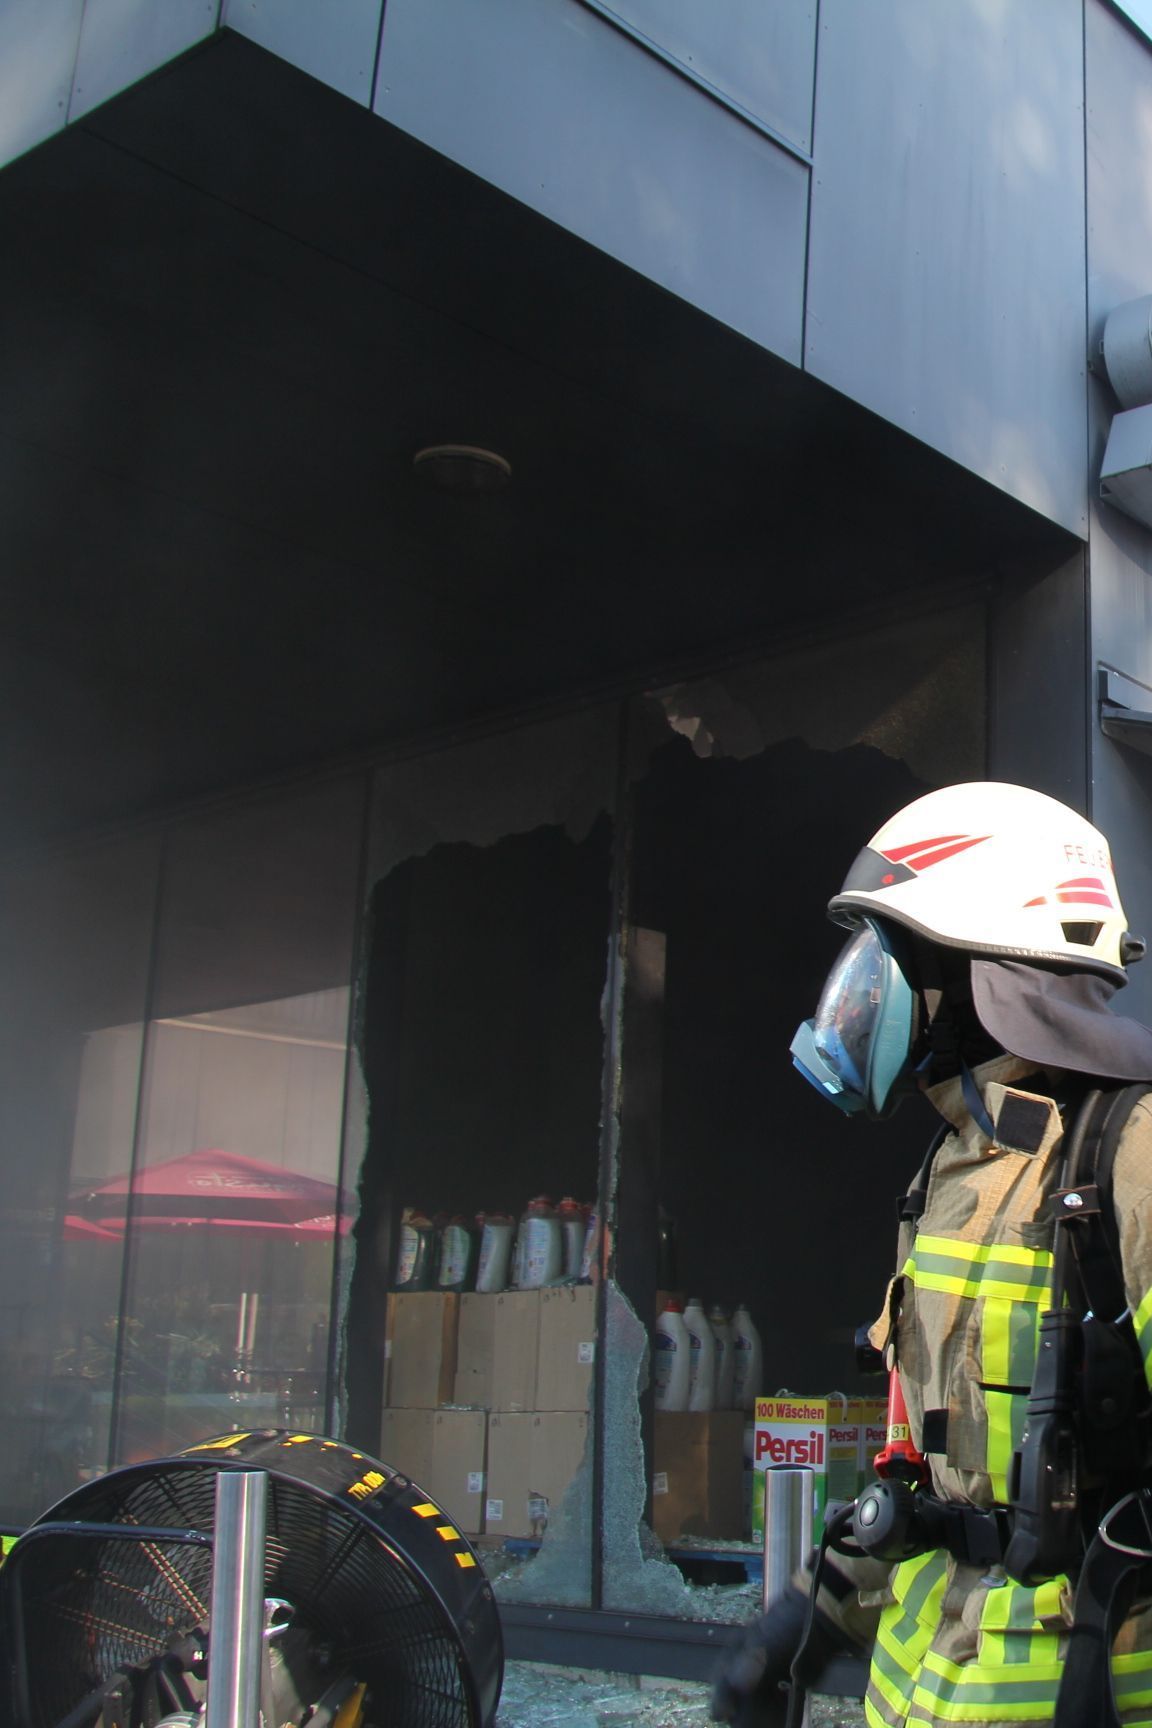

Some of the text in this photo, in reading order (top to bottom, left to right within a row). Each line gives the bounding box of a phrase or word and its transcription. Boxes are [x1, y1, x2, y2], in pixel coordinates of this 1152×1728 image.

[757, 1403, 773, 1417] 100
[776, 1403, 824, 1420] Wäschen
[829, 1427, 859, 1442] Persil
[865, 1427, 887, 1441] Pers
[755, 1431, 824, 1465] Persil
